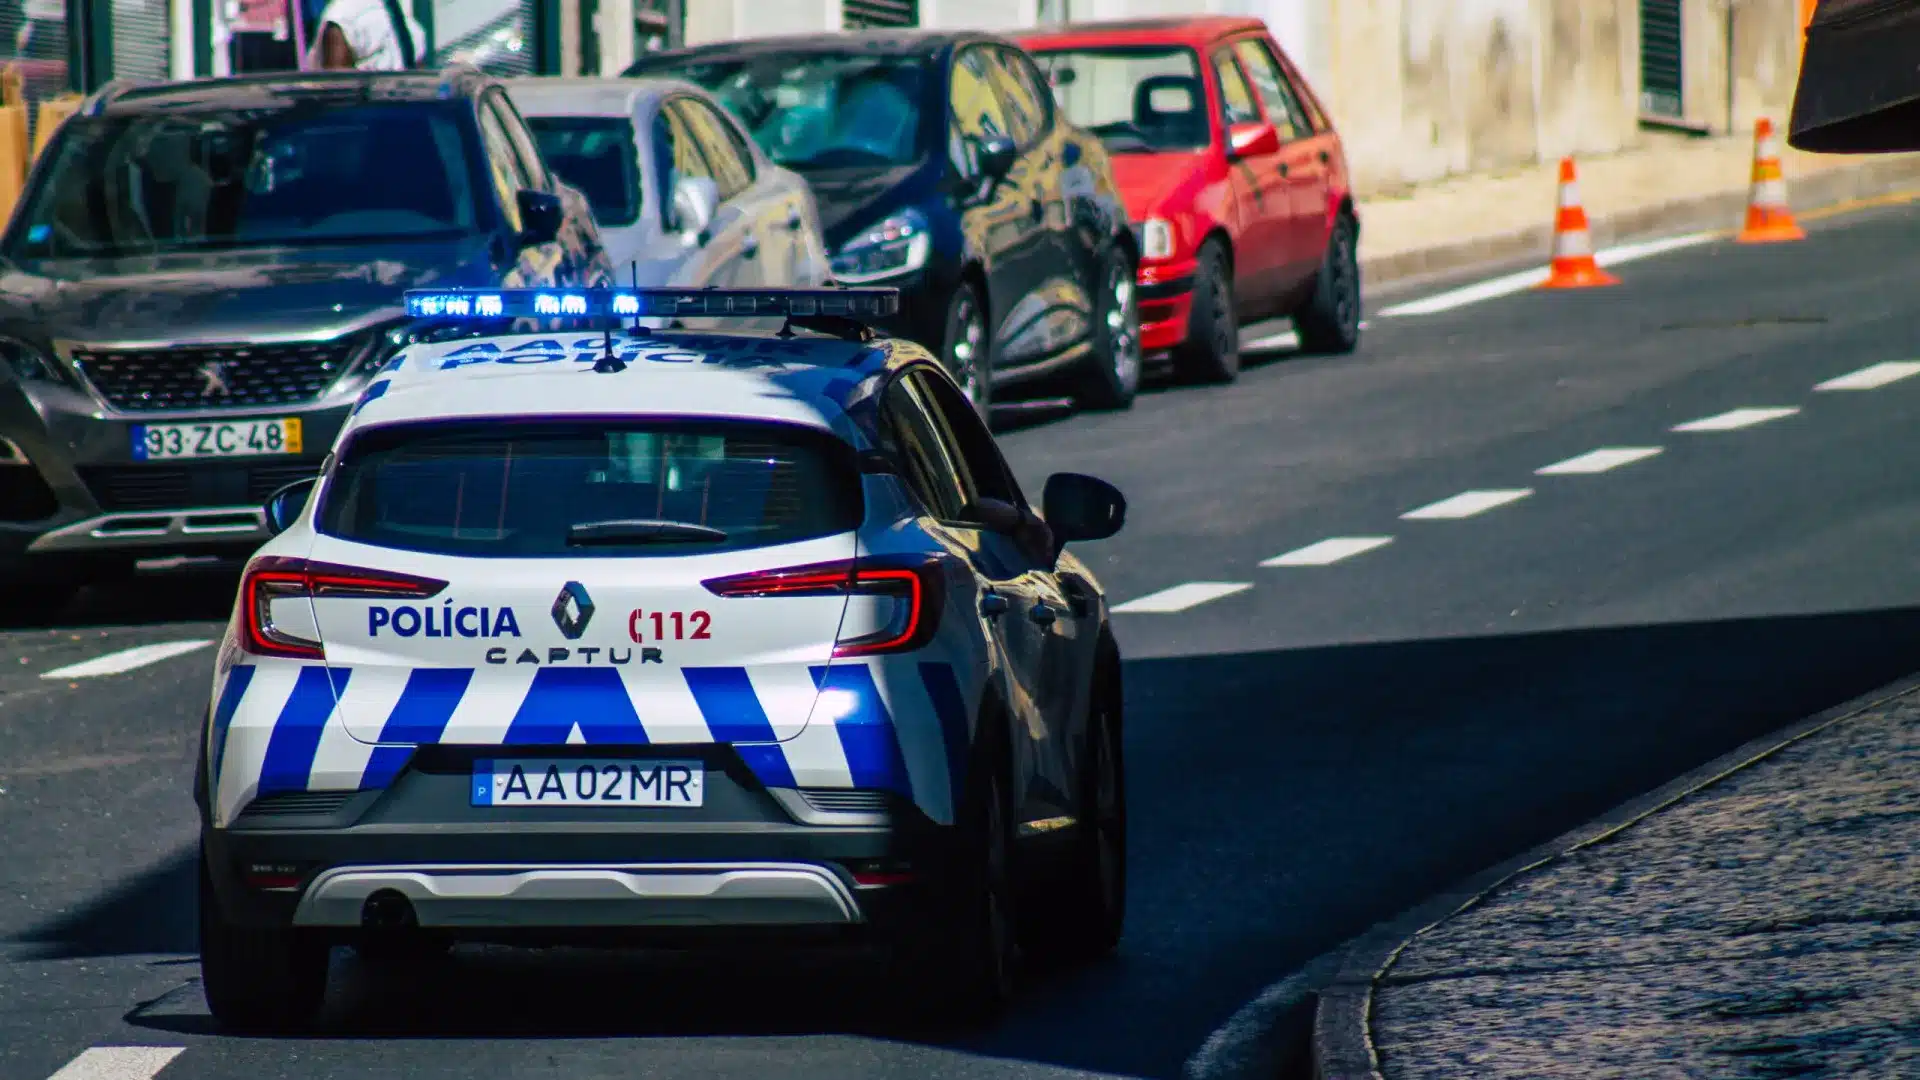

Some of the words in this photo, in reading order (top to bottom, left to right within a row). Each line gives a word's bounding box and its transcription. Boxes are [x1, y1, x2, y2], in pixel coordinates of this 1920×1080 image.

[368, 598, 522, 638] POLÍCIA
[650, 611, 712, 640] 112
[485, 647, 664, 665] CAPTUR
[478, 786, 486, 797] P
